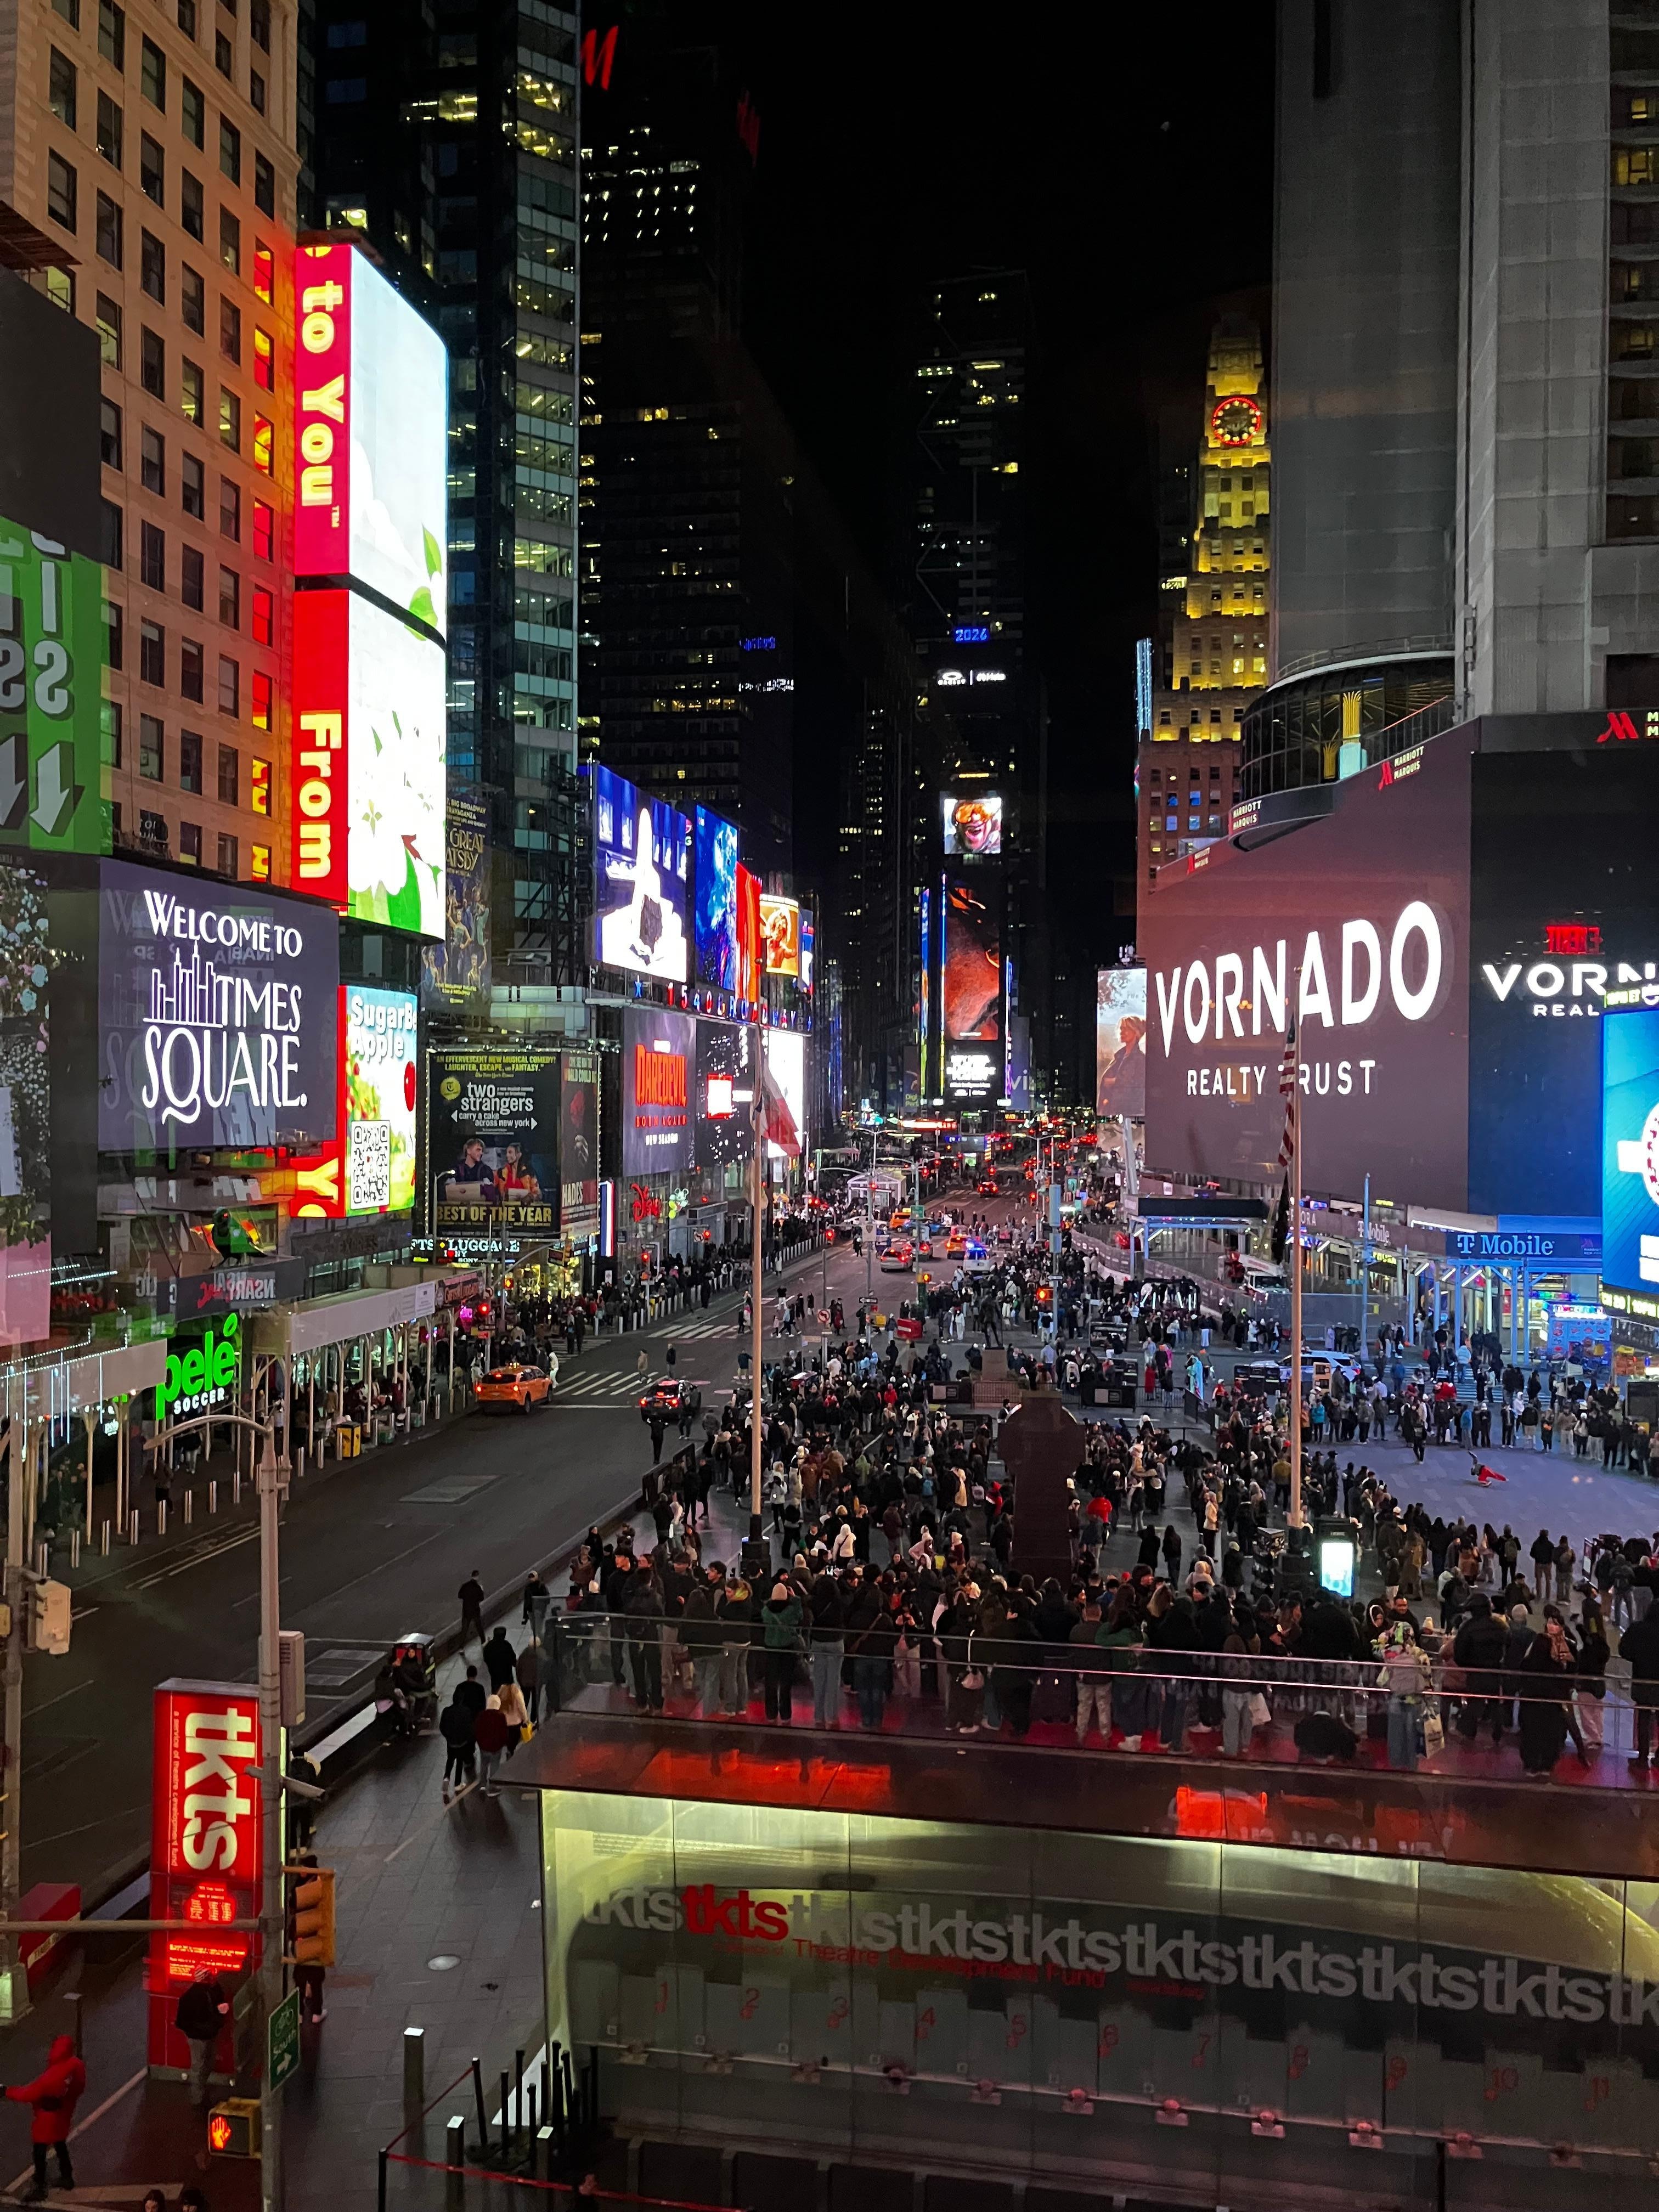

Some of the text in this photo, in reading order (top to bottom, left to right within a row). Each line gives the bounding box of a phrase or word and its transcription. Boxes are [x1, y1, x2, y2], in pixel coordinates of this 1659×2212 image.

[302, 280, 345, 506] to You
[955, 628, 988, 642] 2026
[1394, 746, 1424, 767] MARRIOTT
[1394, 760, 1421, 780] MARQUIS
[300, 710, 342, 878] From
[447, 806, 476, 820] TRAVAGANZA
[1233, 800, 1262, 818] MARRIOTT
[1233, 814, 1257, 830] MARQUIS
[450, 828, 486, 854] GREAT
[446, 848, 479, 871] ATSBY
[143, 889, 303, 957] WELCOME TO
[1156, 900, 1442, 1058] VORNADO
[216, 974, 302, 1033] TIMES
[667, 981, 713, 1013] 1540
[349, 1026, 405, 1061] Apple
[635, 1043, 687, 1107] DAREDEVIL
[1186, 1065, 1266, 1097] REALTY
[467, 1081, 496, 1098] two
[459, 1113, 477, 1122] carry
[461, 1097, 534, 1115] strangers
[514, 1119, 530, 1128] york
[562, 1181, 583, 1207] HADES
[437, 1206, 467, 1221] BEST
[470, 1206, 488, 1221] OF
[491, 1206, 515, 1221] THE
[519, 1206, 552, 1222] YEAR
[1480, 1234, 1554, 1256] Mobile
[155, 1313, 238, 1420] pelé
[173, 1387, 225, 1415] SOCCER
[183, 1707, 256, 1871] tkts
[681, 1883, 789, 1940] tkts
[896, 1902, 1014, 1963] tkts
[1008, 1913, 1121, 1975] tkts
[1120, 1923, 1238, 1987] tkts
[1238, 1934, 1357, 1997] tkts
[1357, 1946, 1479, 2012] tkts
[1479, 1959, 1606, 2024] tkts
